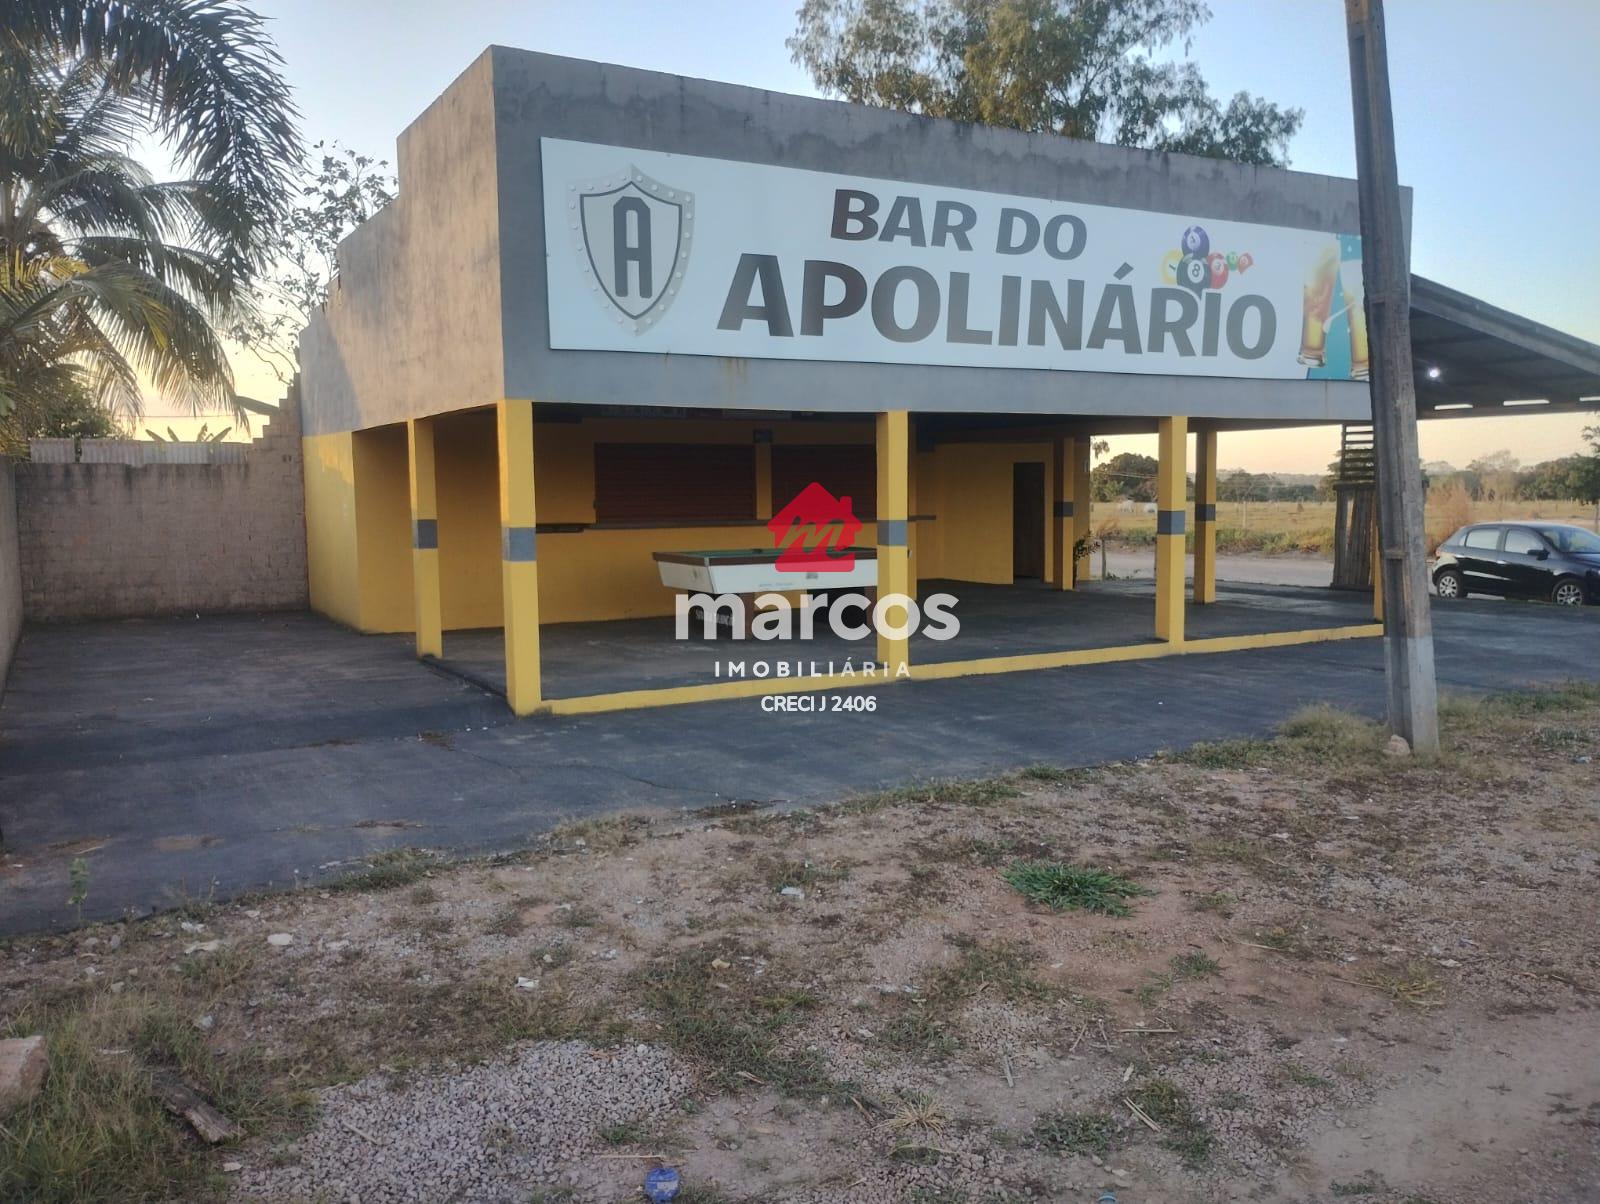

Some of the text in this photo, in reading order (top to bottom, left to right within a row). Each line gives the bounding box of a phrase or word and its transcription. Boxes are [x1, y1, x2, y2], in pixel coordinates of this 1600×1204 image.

[612, 196, 653, 299] A
[831, 189, 1088, 260] BAR DO
[717, 252, 1277, 360] APOLINÁRIO
[1191, 263, 1201, 278] 8
